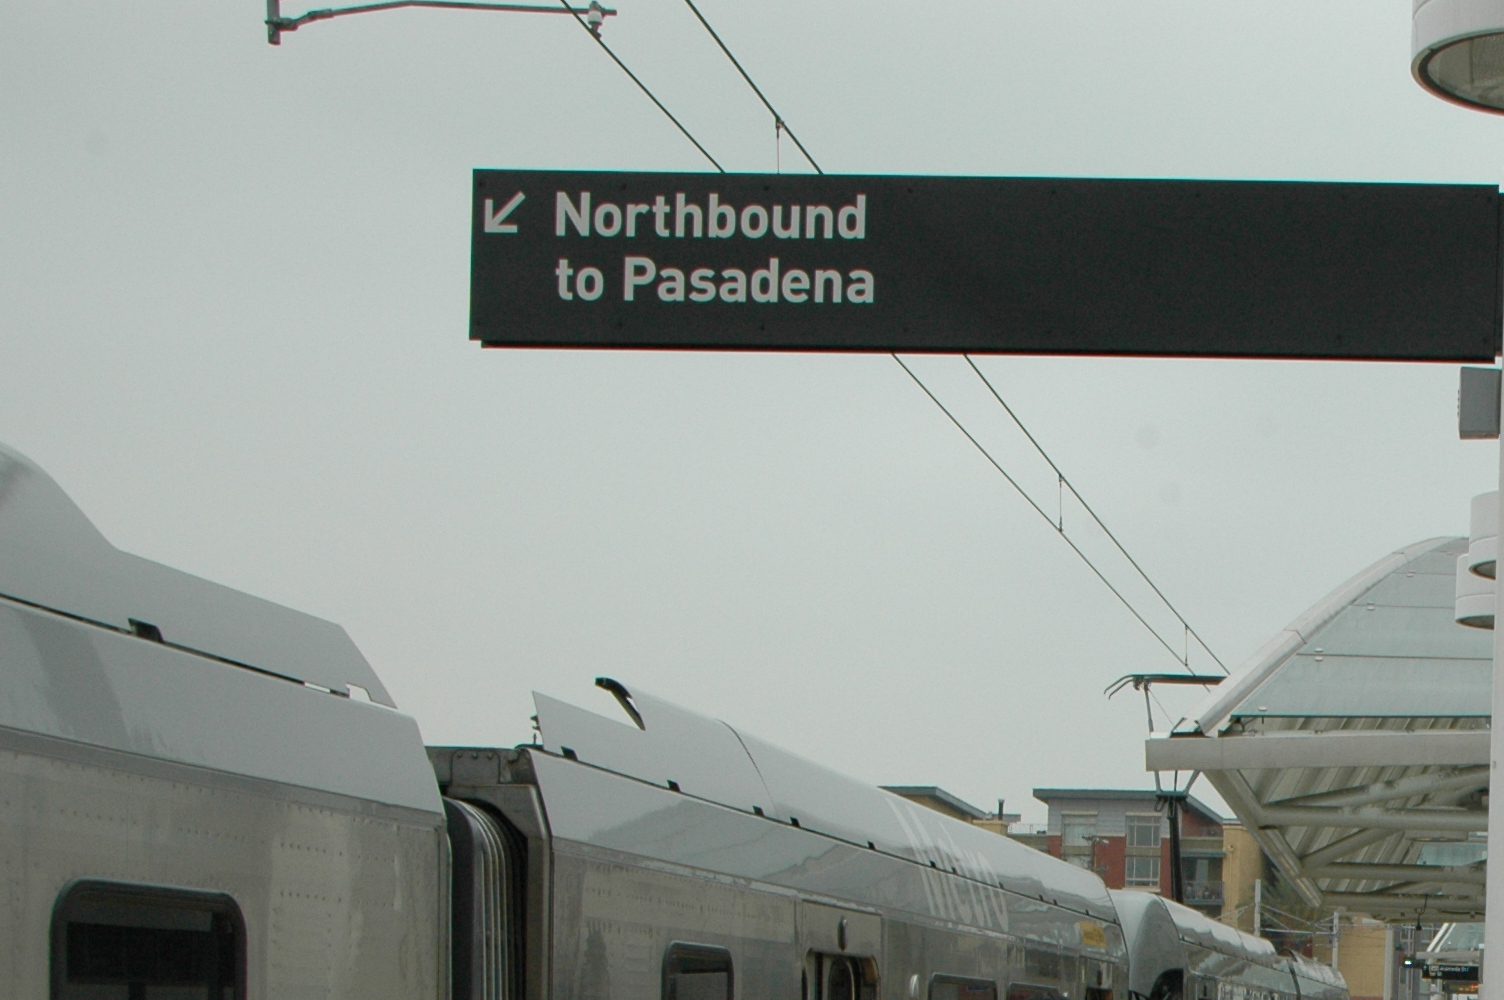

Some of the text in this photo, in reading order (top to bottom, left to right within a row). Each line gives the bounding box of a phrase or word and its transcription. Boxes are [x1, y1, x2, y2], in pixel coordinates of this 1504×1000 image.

[555, 191, 866, 240] Northbound
[555, 256, 874, 303] to Pasadena
